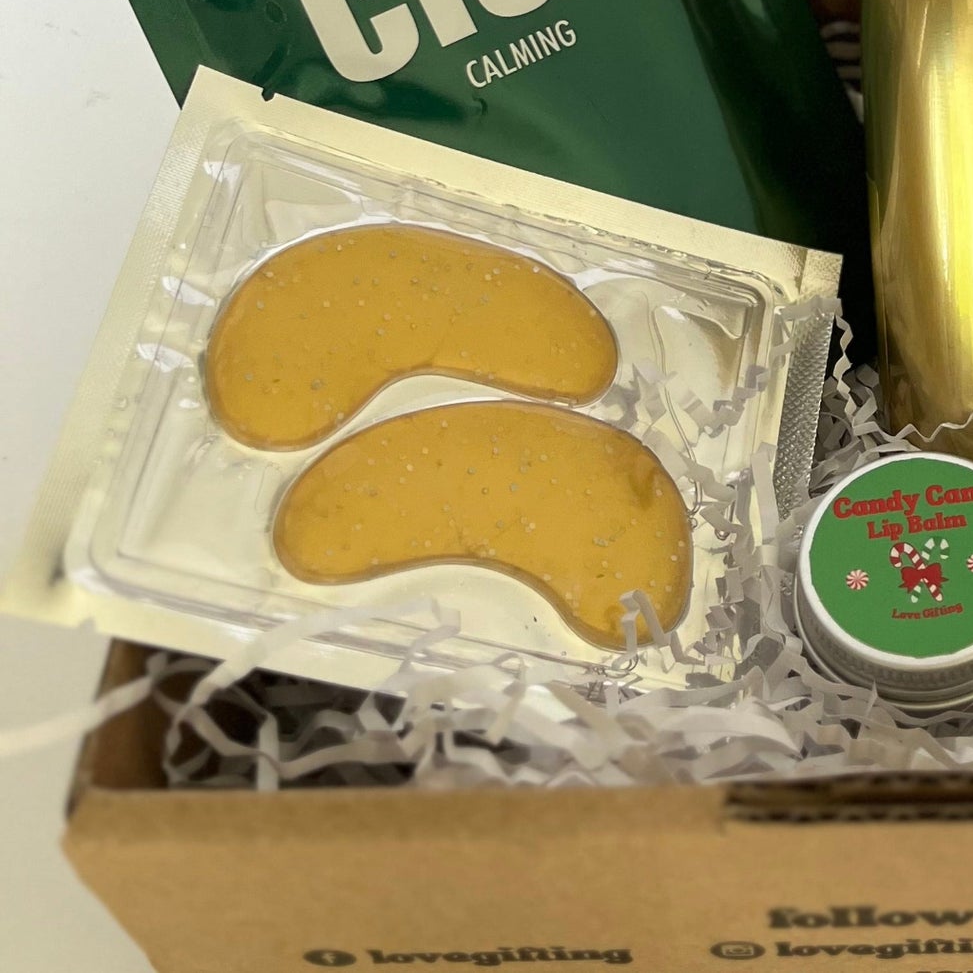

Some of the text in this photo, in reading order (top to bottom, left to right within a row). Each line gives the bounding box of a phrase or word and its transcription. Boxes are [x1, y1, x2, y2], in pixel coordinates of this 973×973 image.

[465, 19, 578, 89] CALMING
[833, 490, 920, 519] Candy
[867, 513, 967, 541] Lip Balm
[366, 946, 634, 967] lovegifting
